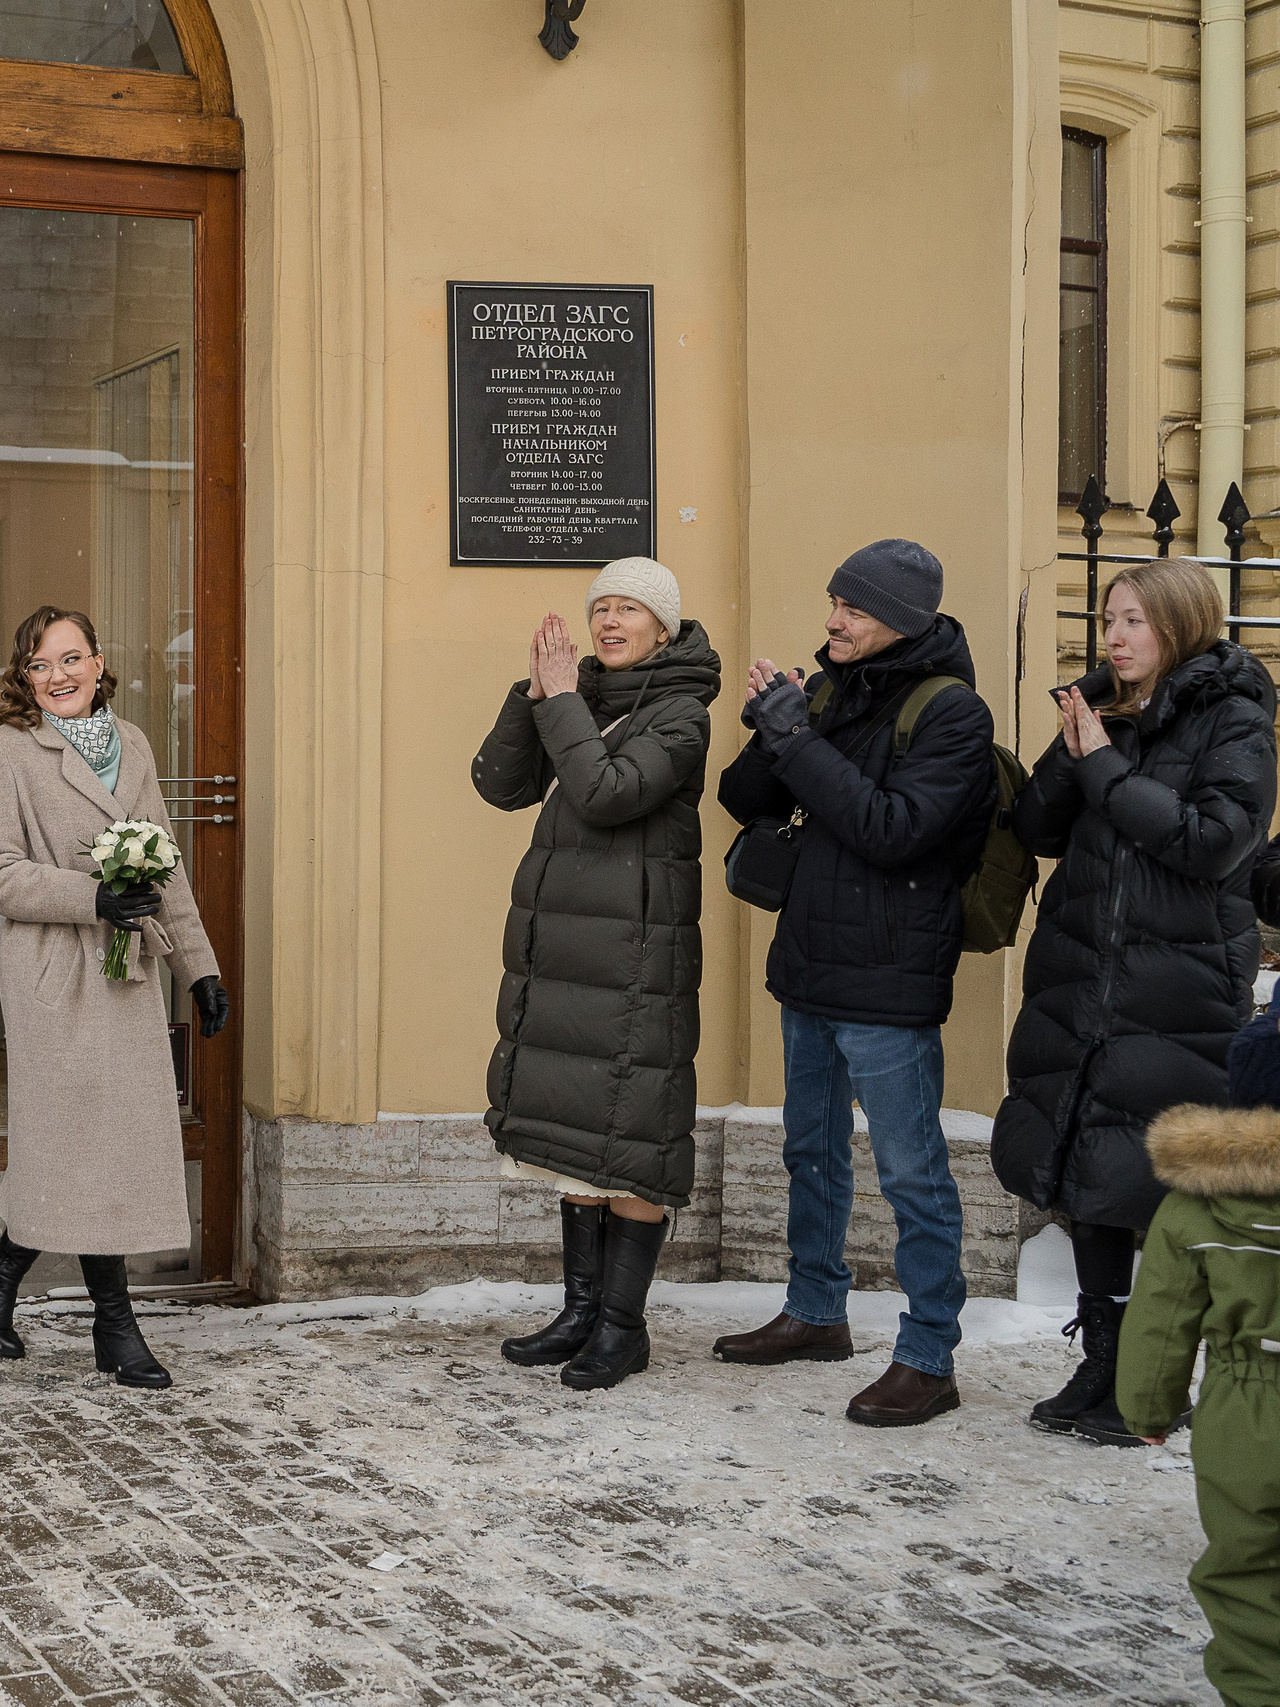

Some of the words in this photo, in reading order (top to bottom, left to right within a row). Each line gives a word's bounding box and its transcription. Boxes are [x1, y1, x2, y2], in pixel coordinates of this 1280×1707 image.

[473, 303, 556, 327] ОТДЕЛ
[566, 304, 630, 325] ЗАГС
[471, 325, 634, 345] ПЕТРОГРАДСКОГО
[516, 341, 588, 360] РАЙОНА
[491, 368, 541, 380] ПРИЕМ
[545, 369, 615, 383] ГРАЖДАН
[485, 386, 568, 395] ВТОРНИК-ПЯТНИЦА
[507, 397, 546, 405] СУББОТА
[507, 409, 548, 418] ПЕРЕРЫВ
[491, 423, 540, 435] ПРИЕМ
[546, 424, 617, 438] ГРАЖДАН
[502, 438, 608, 451] НАЧАЛЬНИКОМ
[505, 452, 562, 465] ОТДЕЛА
[568, 453, 604, 465] ЗАГС
[510, 470, 549, 479] ВТОРНИК
[509, 483, 547, 491] ЧЕТВЕРГ
[626, 498, 650, 507] ДЕНЬ
[513, 505, 571, 514] САНИТАРНЫЙ
[471, 514, 524, 524] ПОСЛЕДНИЙ
[526, 516, 566, 524] РАБОЧИЙ
[568, 516, 592, 525] ДЕНЬ
[594, 517, 639, 525] КВАРТАЛА
[501, 525, 542, 533] ТЕЛЕФОН
[544, 525, 579, 534] ОТДЕЛА
